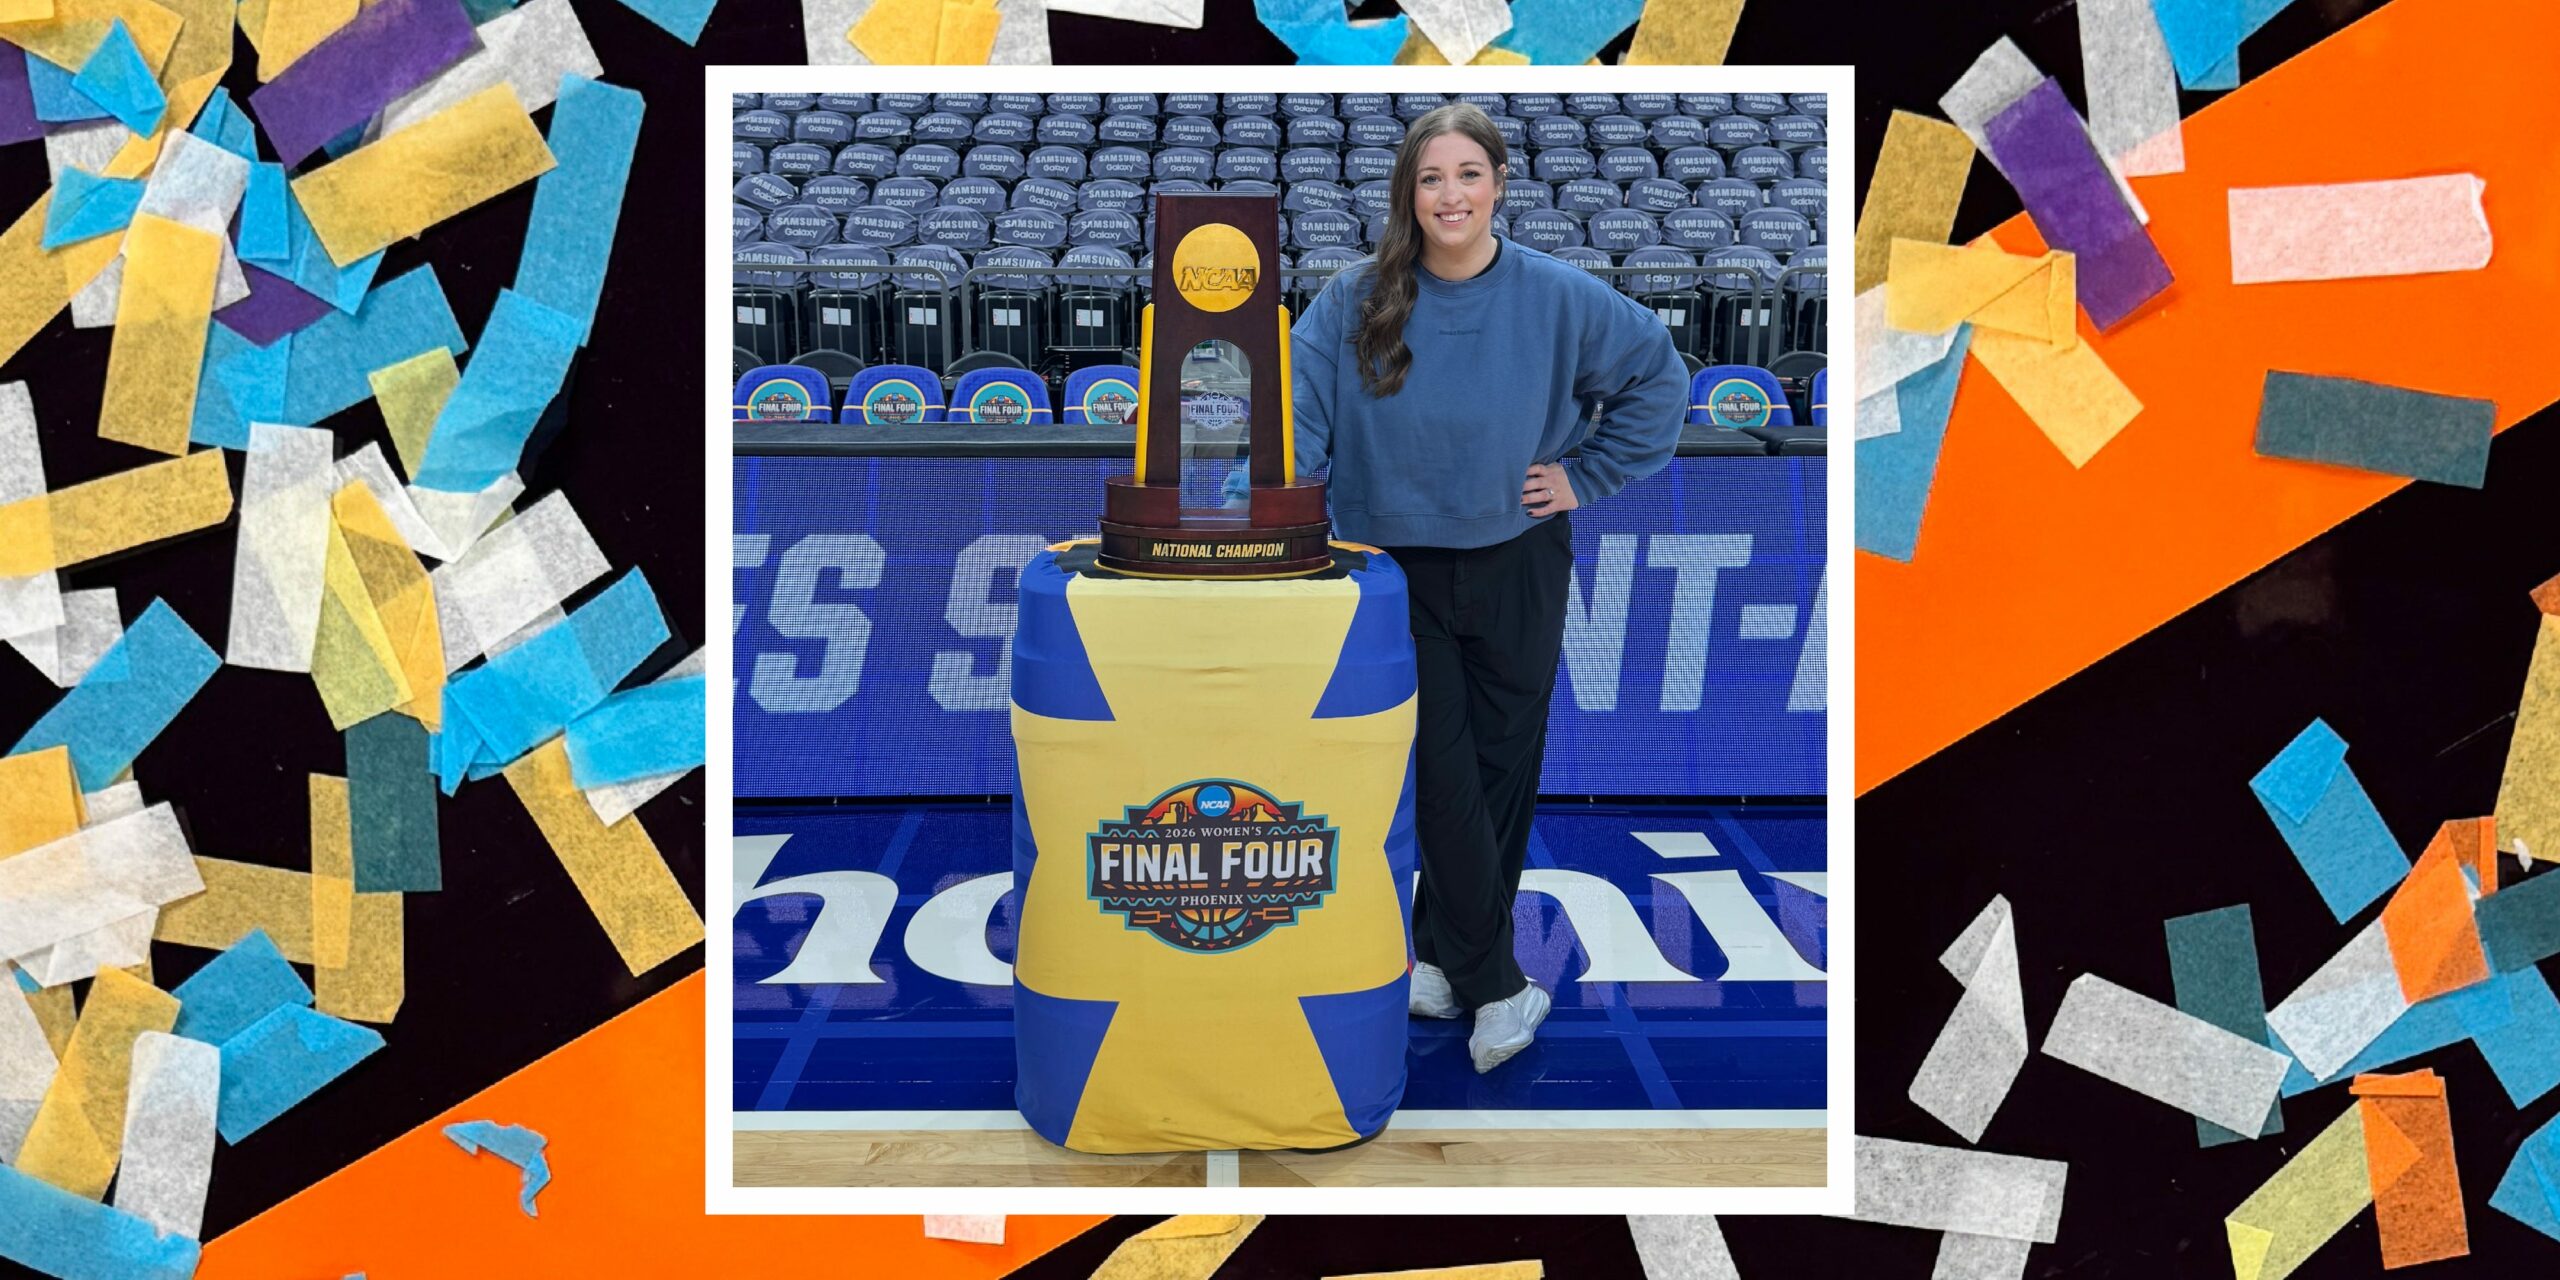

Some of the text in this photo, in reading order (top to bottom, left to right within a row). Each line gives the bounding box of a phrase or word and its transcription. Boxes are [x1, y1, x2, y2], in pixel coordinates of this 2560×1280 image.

[740, 117, 780, 125] SAMSUNG
[922, 118, 962, 126] SAMSUNG
[1296, 121, 1336, 129] SAMSUNG
[746, 125, 772, 133] Galaxy
[989, 128, 1015, 136] Galaxy
[1303, 129, 1328, 137] Galaxy
[1669, 129, 1695, 137] Galaxy
[1114, 130, 1140, 138] Galaxy
[1178, 133, 1204, 141] Galaxy
[1364, 133, 1390, 141] Galaxy
[1547, 132, 1573, 140] Galaxy
[1608, 132, 1634, 140] Galaxy
[1787, 130, 1813, 138] Galaxy
[777, 153, 819, 161] SAMSUNG
[842, 153, 884, 161] SAMSUNG
[906, 154, 949, 162] SAMSUNG
[972, 154, 1015, 162] SAMSUNG
[1354, 157, 1396, 165] SAMSUNG
[783, 161, 811, 171] Galaxy
[849, 162, 876, 170] Galaxy
[913, 164, 941, 172] Galaxy
[979, 163, 1007, 172] Galaxy
[1043, 164, 1069, 172] Galaxy
[1106, 164, 1133, 172] Galaxy
[1170, 165, 1196, 173] Galaxy
[1234, 165, 1260, 173] Galaxy
[1298, 166, 1324, 174] Galaxy
[1361, 166, 1388, 175] Galaxy
[1682, 166, 1710, 174] Galaxy
[1750, 166, 1778, 174] Galaxy
[809, 187, 856, 195] SAMSUNG
[949, 186, 995, 194] SAMSUNG
[1023, 185, 1069, 200] SAMSUNG
[1089, 190, 1133, 198] SAMSUNG
[1297, 186, 1342, 200] SAMSUNG
[1505, 190, 1544, 198] AMSUNG
[1567, 186, 1613, 195] SAMSUNG
[1709, 189, 1755, 197] SAMSUNG
[753, 188, 781, 204] Galaxy
[1574, 195, 1604, 205] Galaxy
[817, 197, 847, 206] Galaxy
[886, 198, 916, 208] Galaxy
[957, 197, 986, 206] Galaxy
[1029, 195, 1058, 209] Galaxy
[1097, 200, 1126, 208] Galaxy
[1303, 196, 1332, 209] Galaxy
[1507, 200, 1535, 208] Galaxy
[1649, 198, 1677, 208] Galaxy
[1717, 199, 1747, 207] Galaxy
[1791, 198, 1819, 206] Galaxy
[777, 217, 826, 226] SAMSUNG
[855, 217, 905, 229] SAMSUNG
[929, 220, 978, 229] SAMSUNG
[1005, 220, 1054, 229] SAMSUNG
[1081, 221, 1129, 229] SAMSUNG
[1525, 222, 1573, 230] SAMSUNG
[1600, 221, 1649, 229] SAMSUNG
[1674, 220, 1725, 228] SAMSUNG
[1752, 221, 1802, 230] SAMSUNG
[1302, 222, 1349, 231] SAMSUNG
[785, 228, 818, 238] Galaxy
[862, 228, 895, 240] Galaxy
[937, 232, 969, 240] Galaxy
[1013, 231, 1045, 241] Galaxy
[1089, 231, 1121, 240] Galaxy
[1533, 232, 1564, 242] Galaxy
[1608, 232, 1640, 241] Galaxy
[1684, 230, 1716, 240] Galaxy
[1761, 232, 1793, 242] Galaxy
[1310, 234, 1341, 242] Galaxy
[737, 253, 794, 264] SAMSUNG
[988, 258, 1042, 267] SAMSUNG
[1067, 255, 1120, 266] SAMSUNG
[903, 258, 957, 272] SAMSUNG
[1717, 258, 1771, 269] SAMSUNG
[1181, 266, 1255, 291] NCAA
[758, 403, 802, 412] FINAL FOUR
[873, 403, 916, 412] FINAL FOUR
[980, 405, 1022, 414] FINAL FOUR
[1092, 403, 1112, 411] FINAL
[1191, 404, 1214, 414] FINAL
[1718, 402, 1760, 411] FINAL FOUR
[1152, 543, 1285, 559] NATIONAL CHAMPION
[1200, 800, 1231, 810] NCAA
[1165, 826, 1262, 838] 2026 WOMEN'S
[1101, 838, 1324, 883] FINAL FOUR
[1180, 894, 1244, 906] PHOENIX
